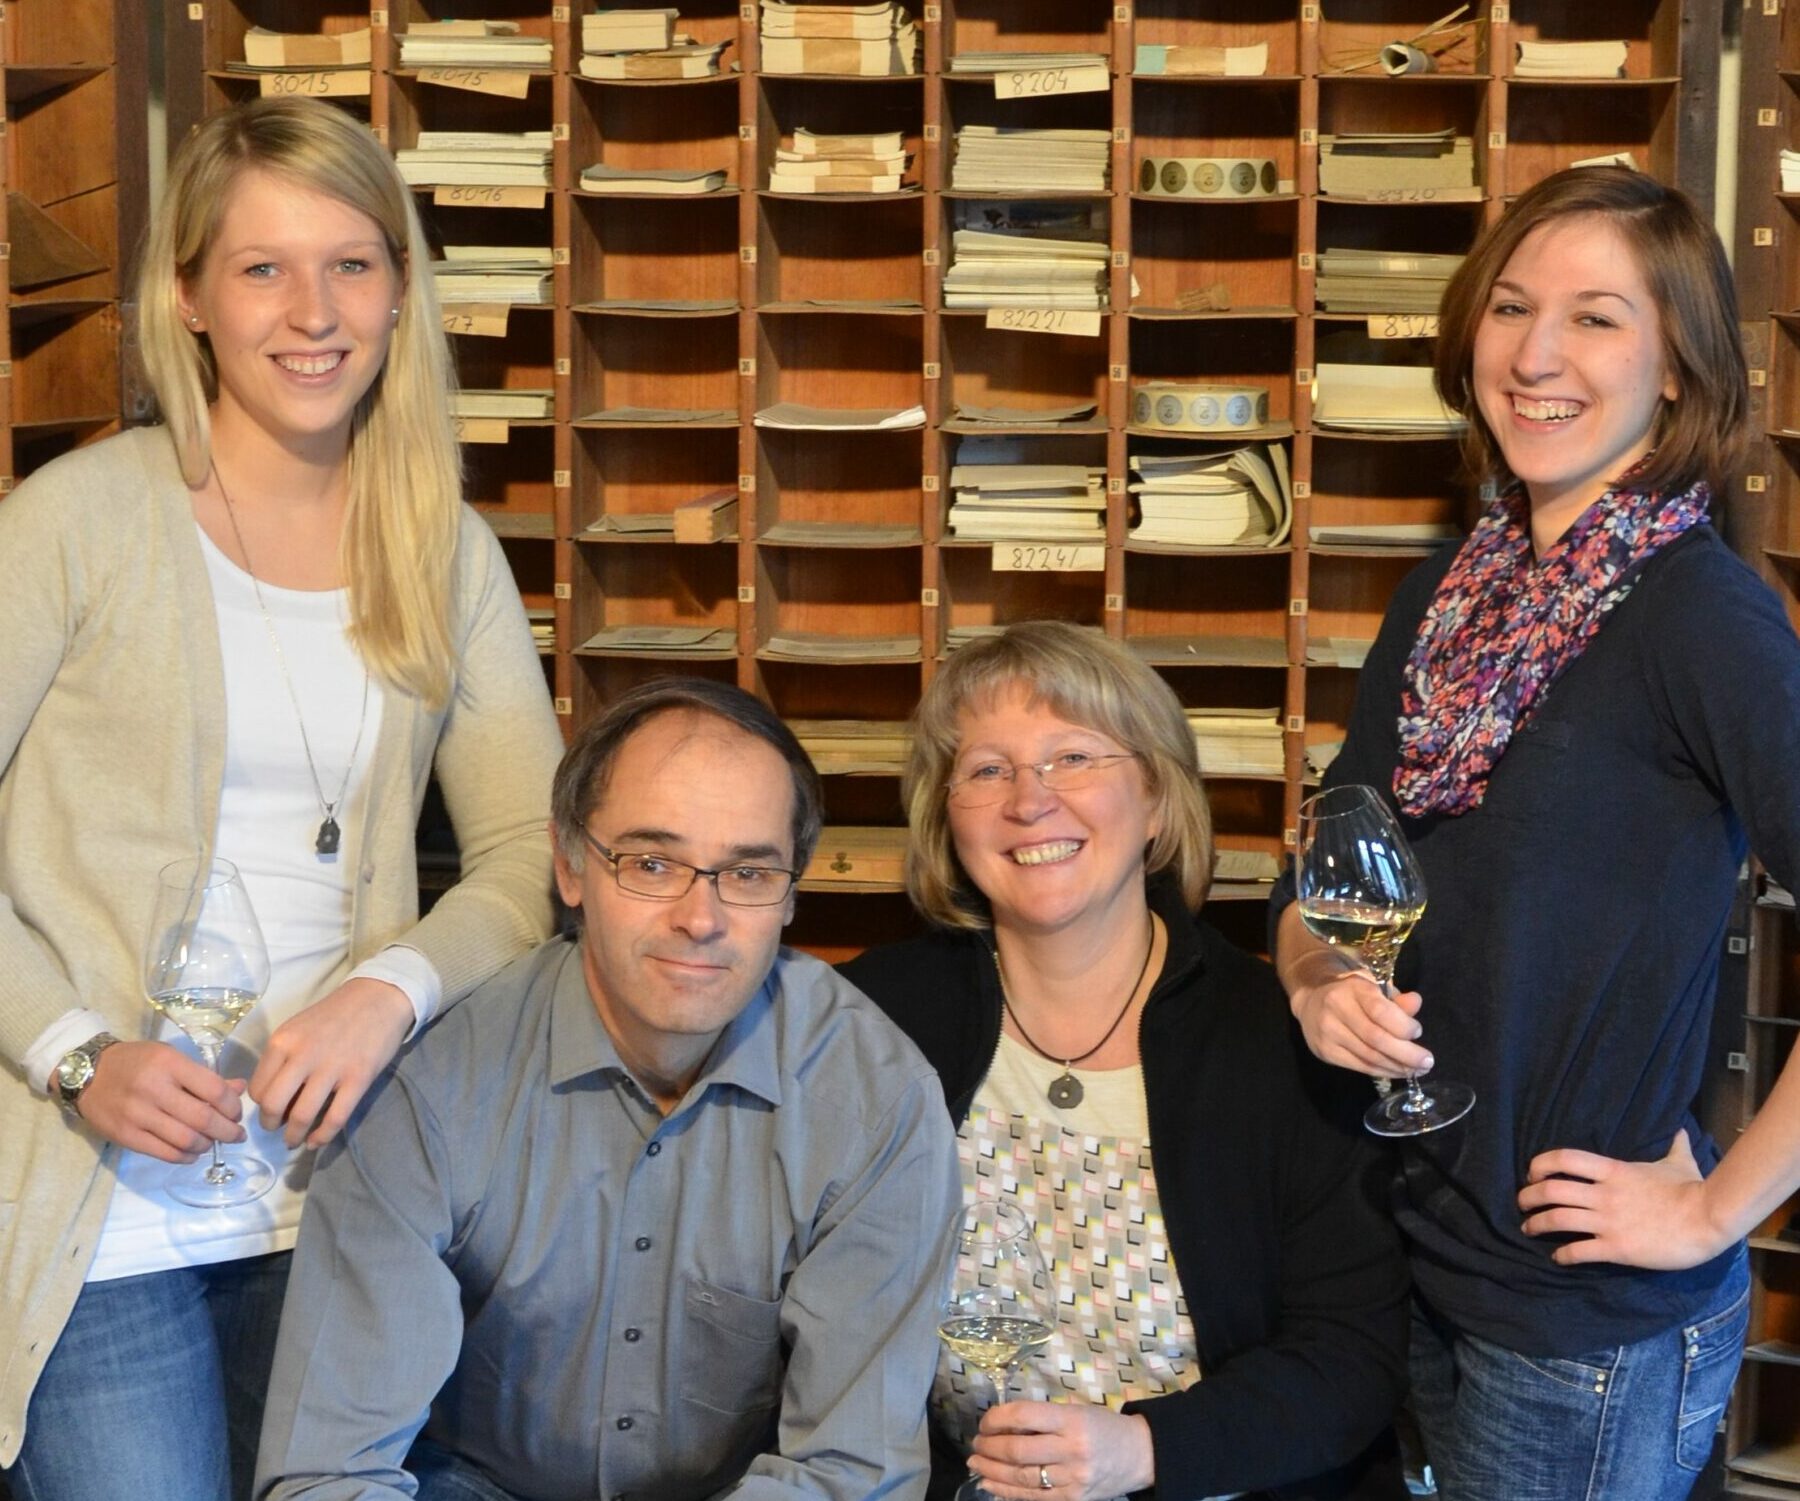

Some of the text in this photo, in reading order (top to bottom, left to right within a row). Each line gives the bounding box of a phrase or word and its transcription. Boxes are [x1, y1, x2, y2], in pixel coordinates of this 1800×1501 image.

[272, 73, 335, 94] 8015
[430, 69, 488, 86] 8015
[1011, 69, 1068, 96] 8204
[450, 188, 505, 201] 8016
[444, 315, 473, 332] 17
